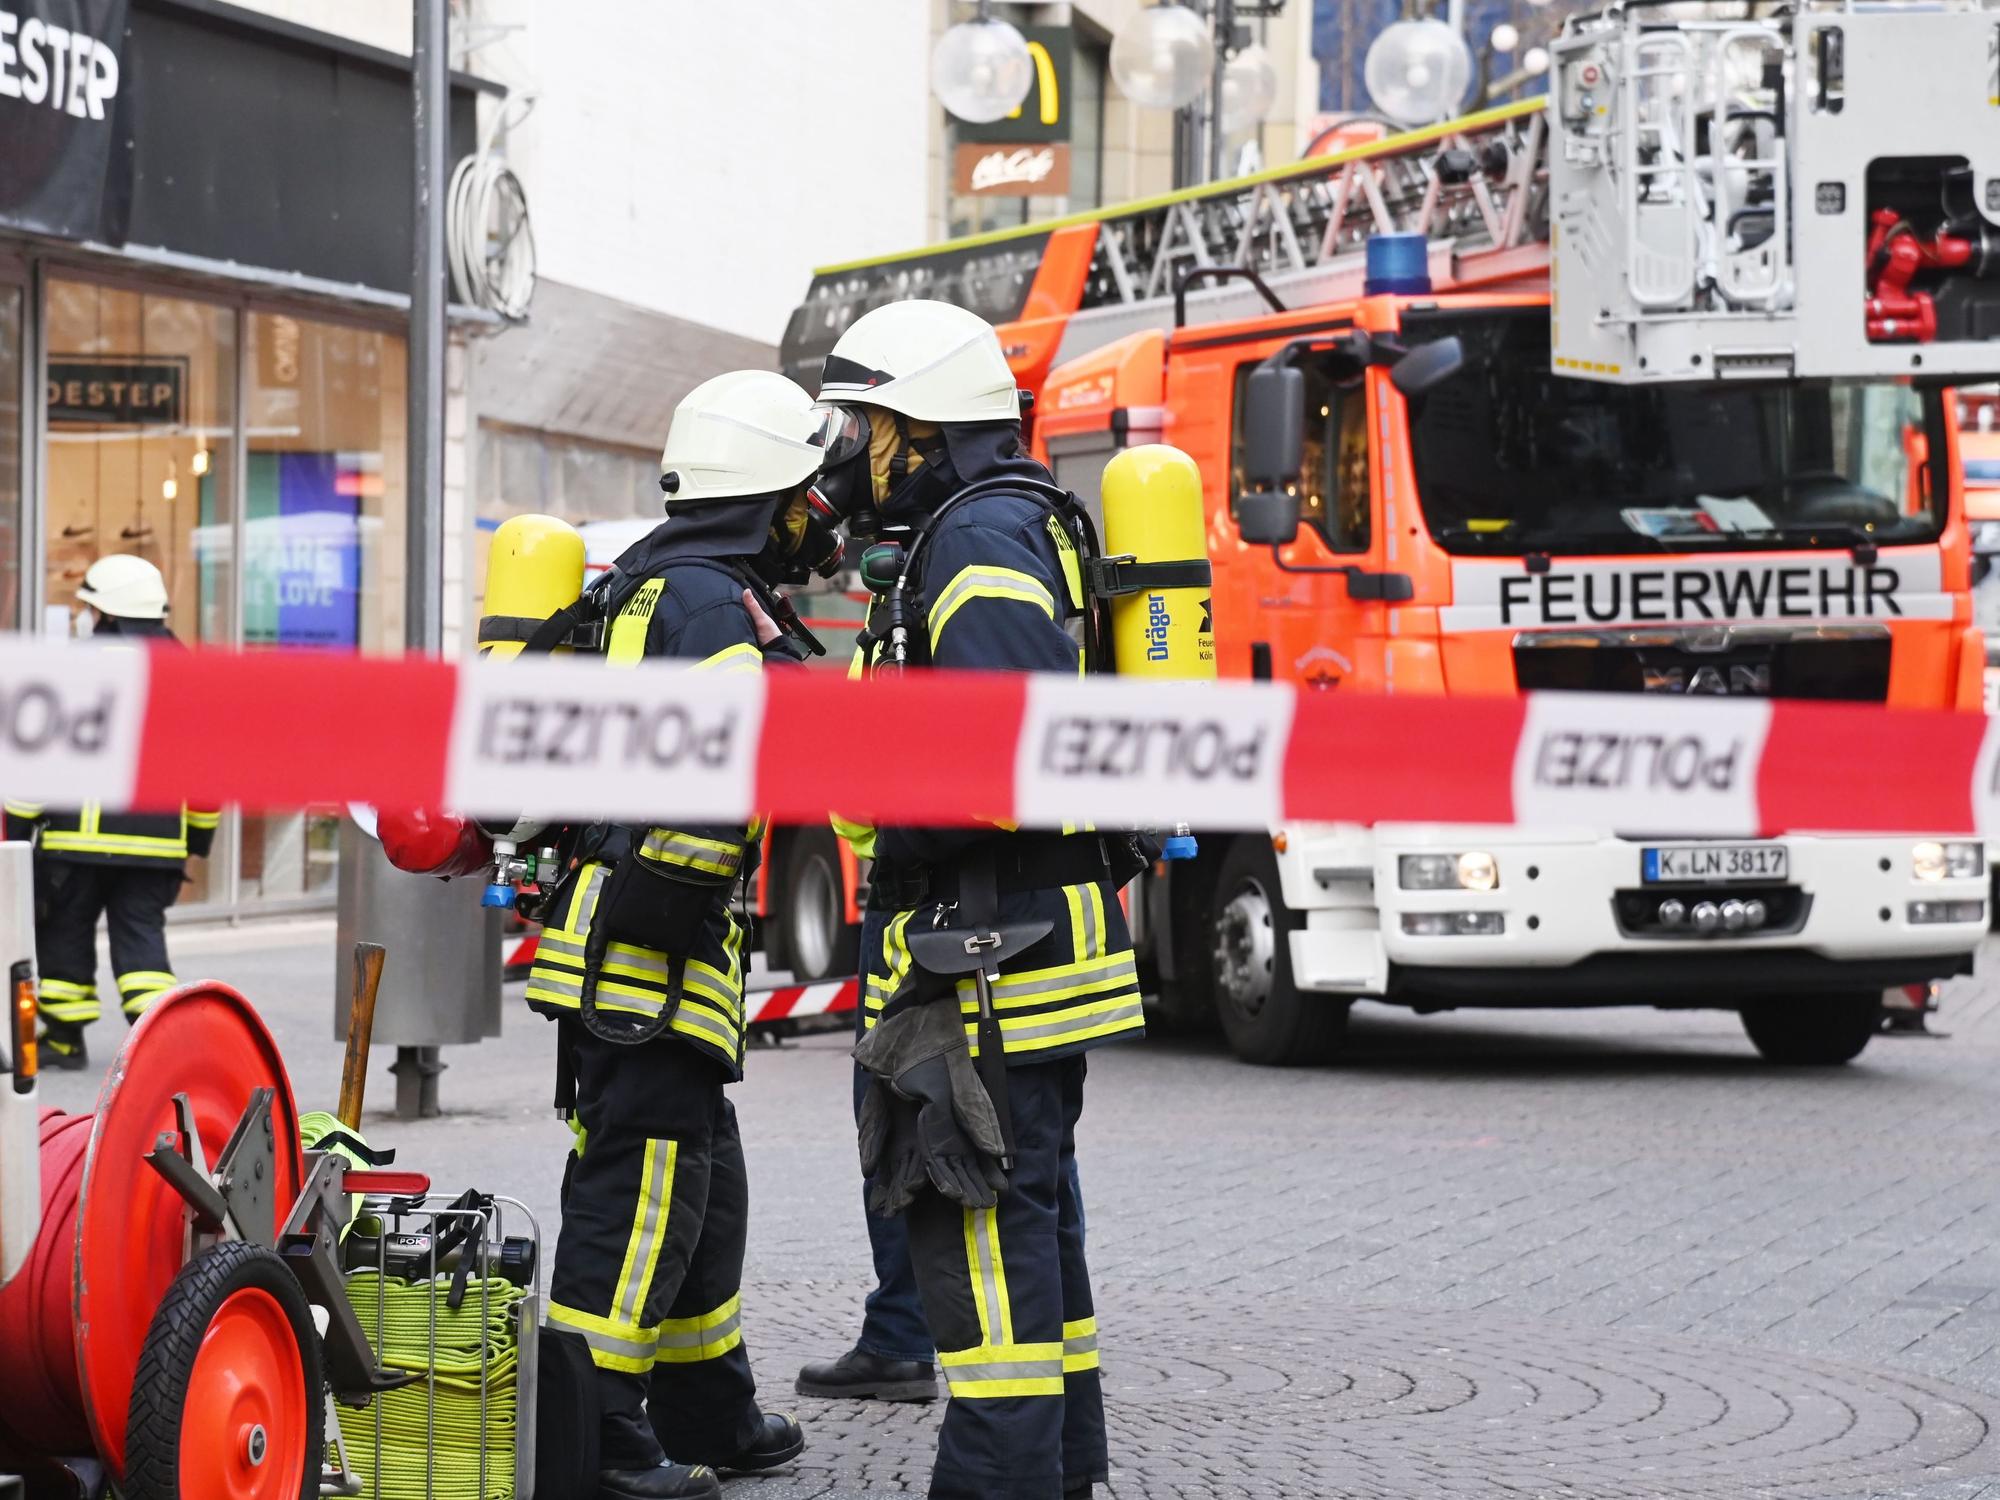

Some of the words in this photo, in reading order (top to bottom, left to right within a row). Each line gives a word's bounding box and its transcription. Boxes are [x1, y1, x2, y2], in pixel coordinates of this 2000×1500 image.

[0, 10, 119, 120] ESTEP
[1501, 568, 1902, 624] FEUERWEHR
[1145, 594, 1170, 661] Dräger
[1643, 664, 1769, 695] MAN
[476, 699, 738, 769] POLIZEI
[1039, 717, 1268, 780] POLIZEI
[1534, 732, 1743, 791] POLIZEI
[1727, 850, 1783, 873] 3817
